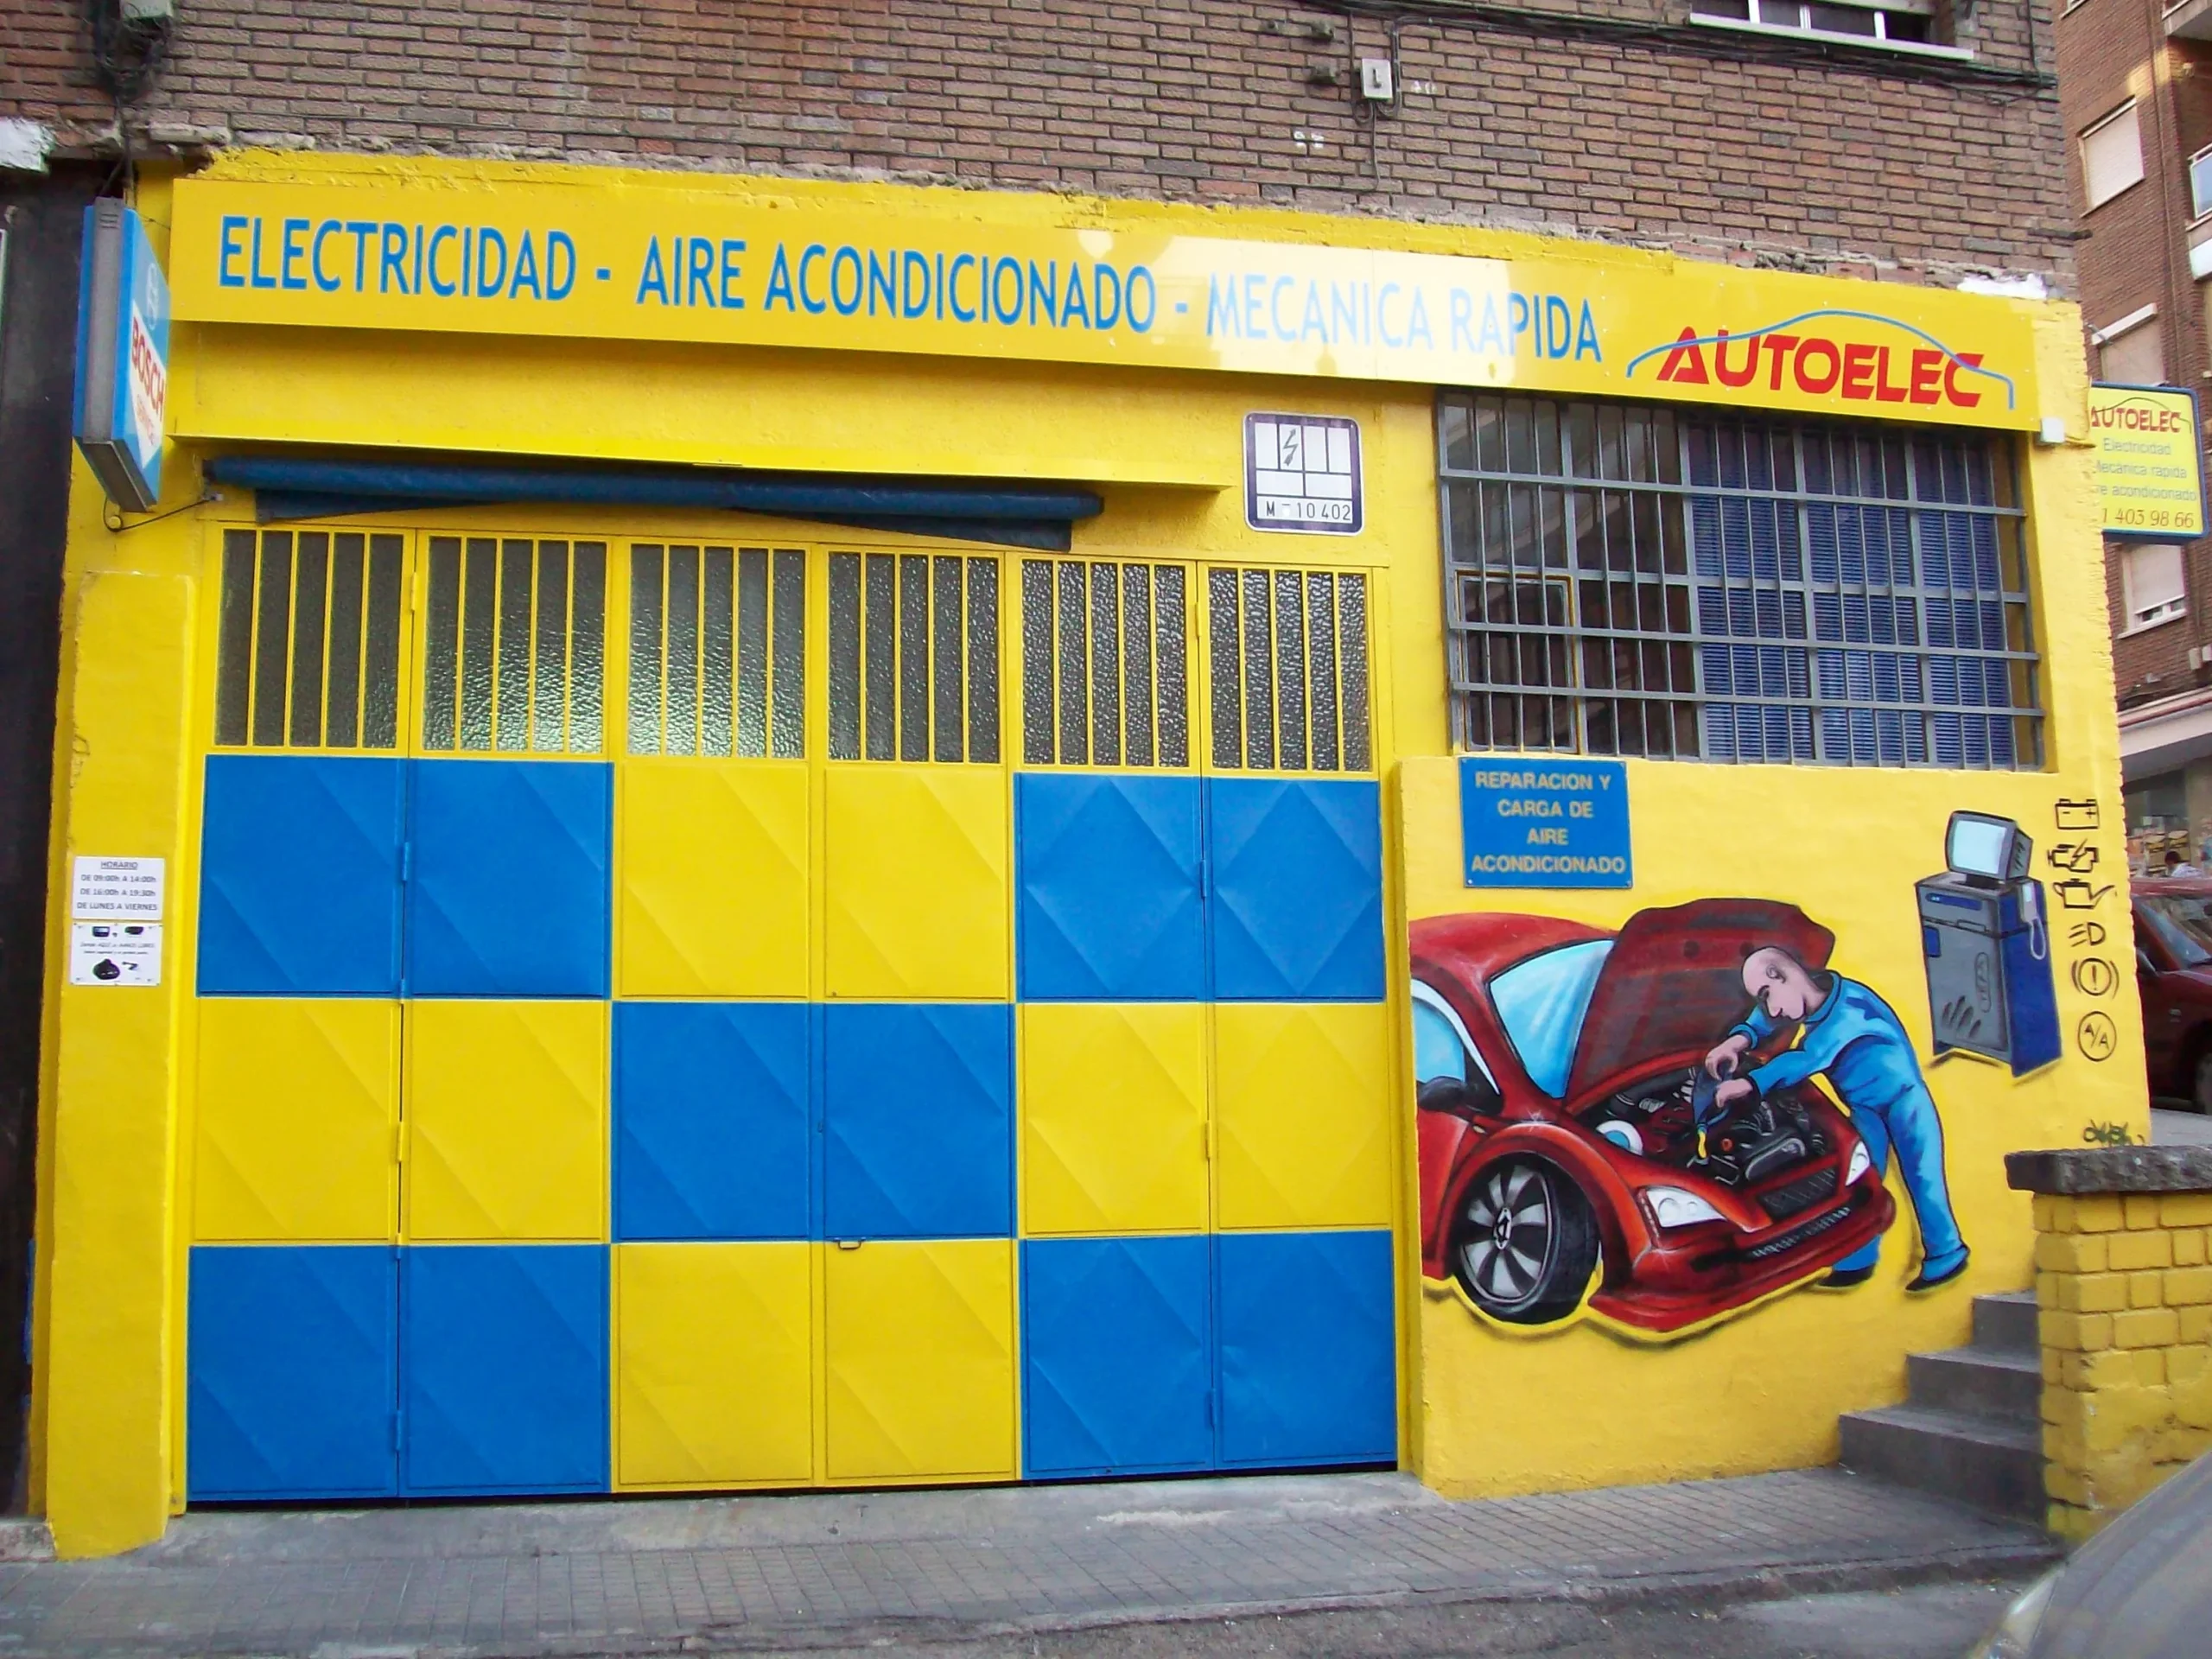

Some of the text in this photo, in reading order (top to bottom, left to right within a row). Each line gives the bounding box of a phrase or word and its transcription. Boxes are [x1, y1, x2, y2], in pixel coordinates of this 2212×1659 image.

[219, 214, 576, 301] ELECTRICIDAD
[636, 234, 747, 310] AIRE
[763, 242, 1157, 334] ACONDICIONADO
[1206, 272, 1434, 351] MECANICA
[1450, 287, 1603, 363] RAPIDA
[131, 315, 165, 423] BOSCH
[1656, 326, 1985, 407] AUTOELEC
[2091, 406, 2181, 433] AUTOELEC
[2103, 437, 2171, 456] Electricidad
[2112, 485, 2198, 501] acondicionado
[2115, 508, 2145, 525] 403
[2150, 510, 2171, 527] 98
[2174, 512, 2195, 529] 66
[1475, 771, 1611, 791] REPARACION Y
[1497, 798, 1594, 817] CARGA DE
[1527, 828, 1569, 845] AIRE
[100, 861, 138, 870] HORARIO
[1471, 855, 1626, 874] ACONDICIONADO
[79, 887, 91, 896] DE
[76, 901, 87, 910] DE
